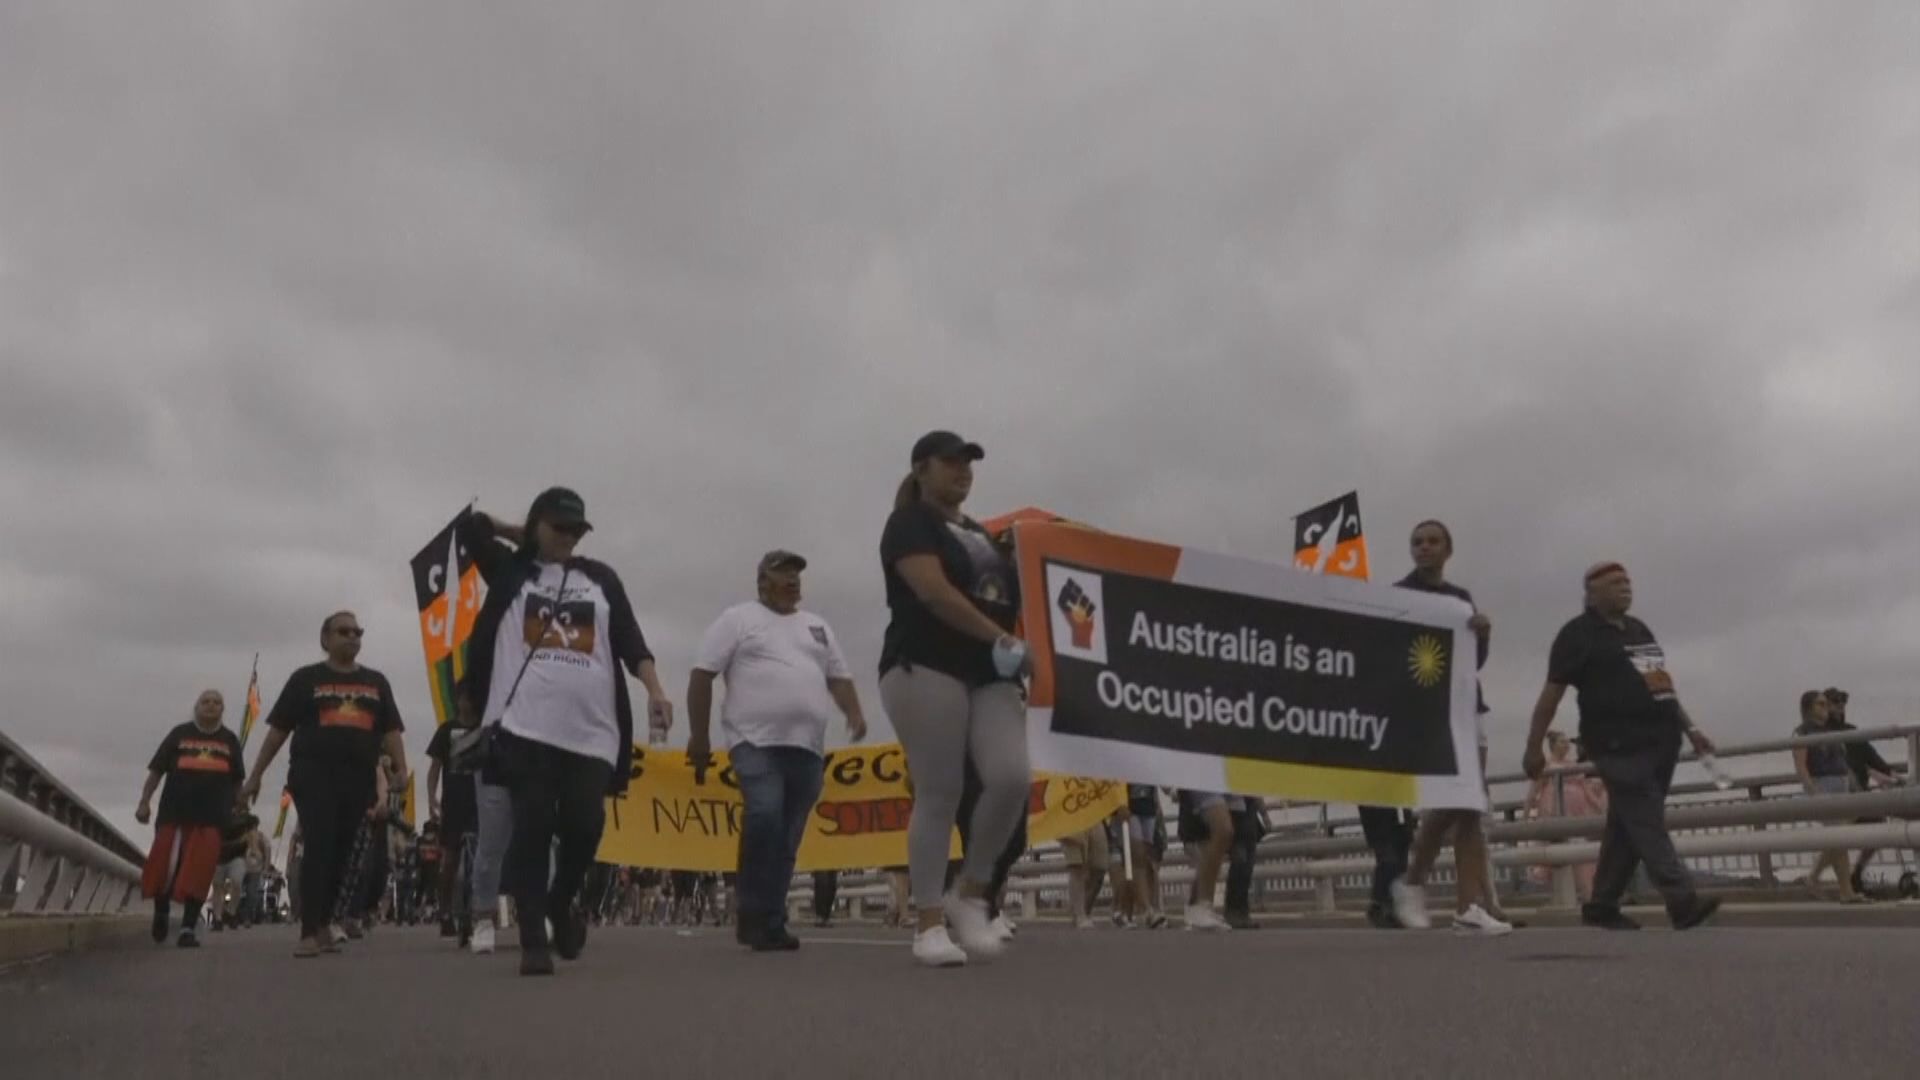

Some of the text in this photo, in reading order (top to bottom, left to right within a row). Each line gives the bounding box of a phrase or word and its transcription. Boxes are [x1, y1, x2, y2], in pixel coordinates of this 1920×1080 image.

[1128, 611, 1355, 677] Australia is an
[1096, 670, 1389, 751] Occupied Country
